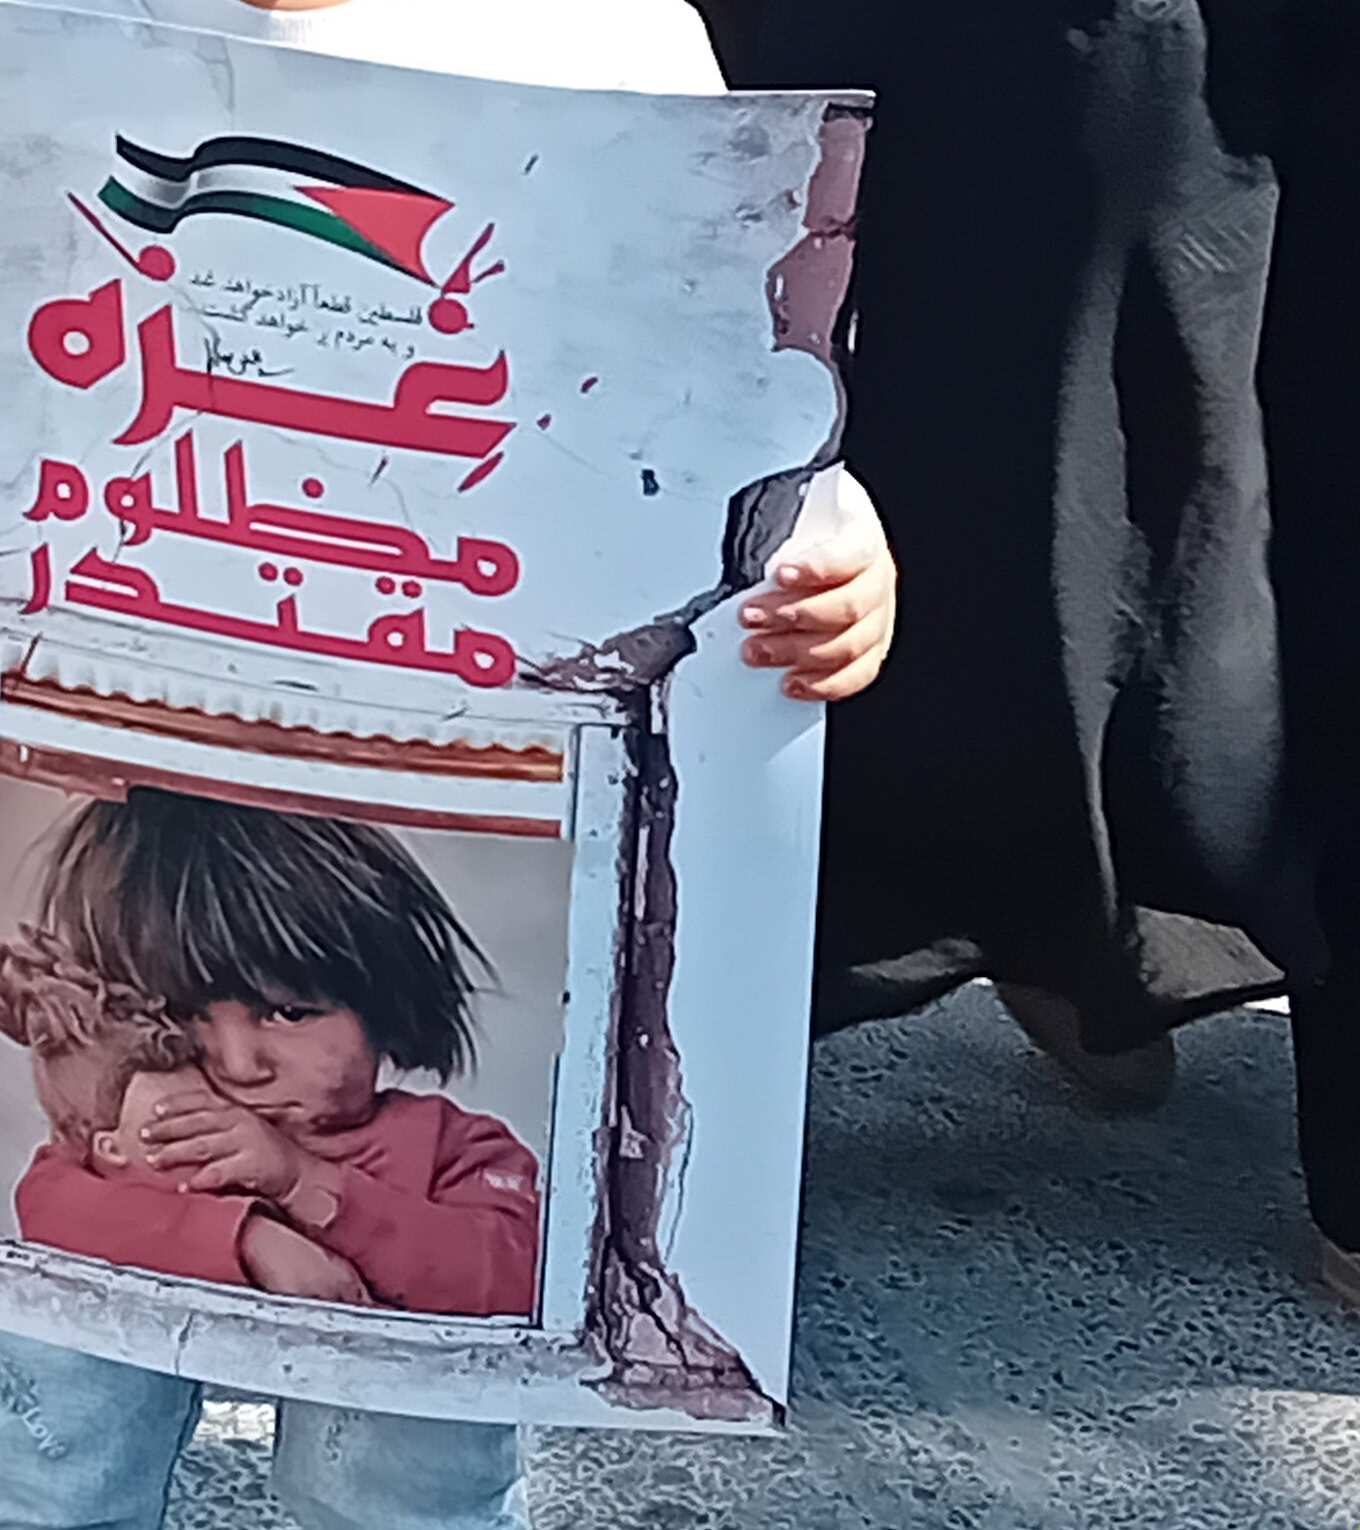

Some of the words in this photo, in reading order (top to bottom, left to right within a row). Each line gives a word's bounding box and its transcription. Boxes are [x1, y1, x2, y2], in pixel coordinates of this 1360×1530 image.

[188, 269, 216, 287] شد
[357, 302, 423, 327] فلسطین
[27, 238, 516, 466] غزه
[334, 330, 375, 352] مردم
[402, 344, 415, 361] و
[23, 428, 521, 598] مظلوم
[21, 544, 517, 689] مقتدر
